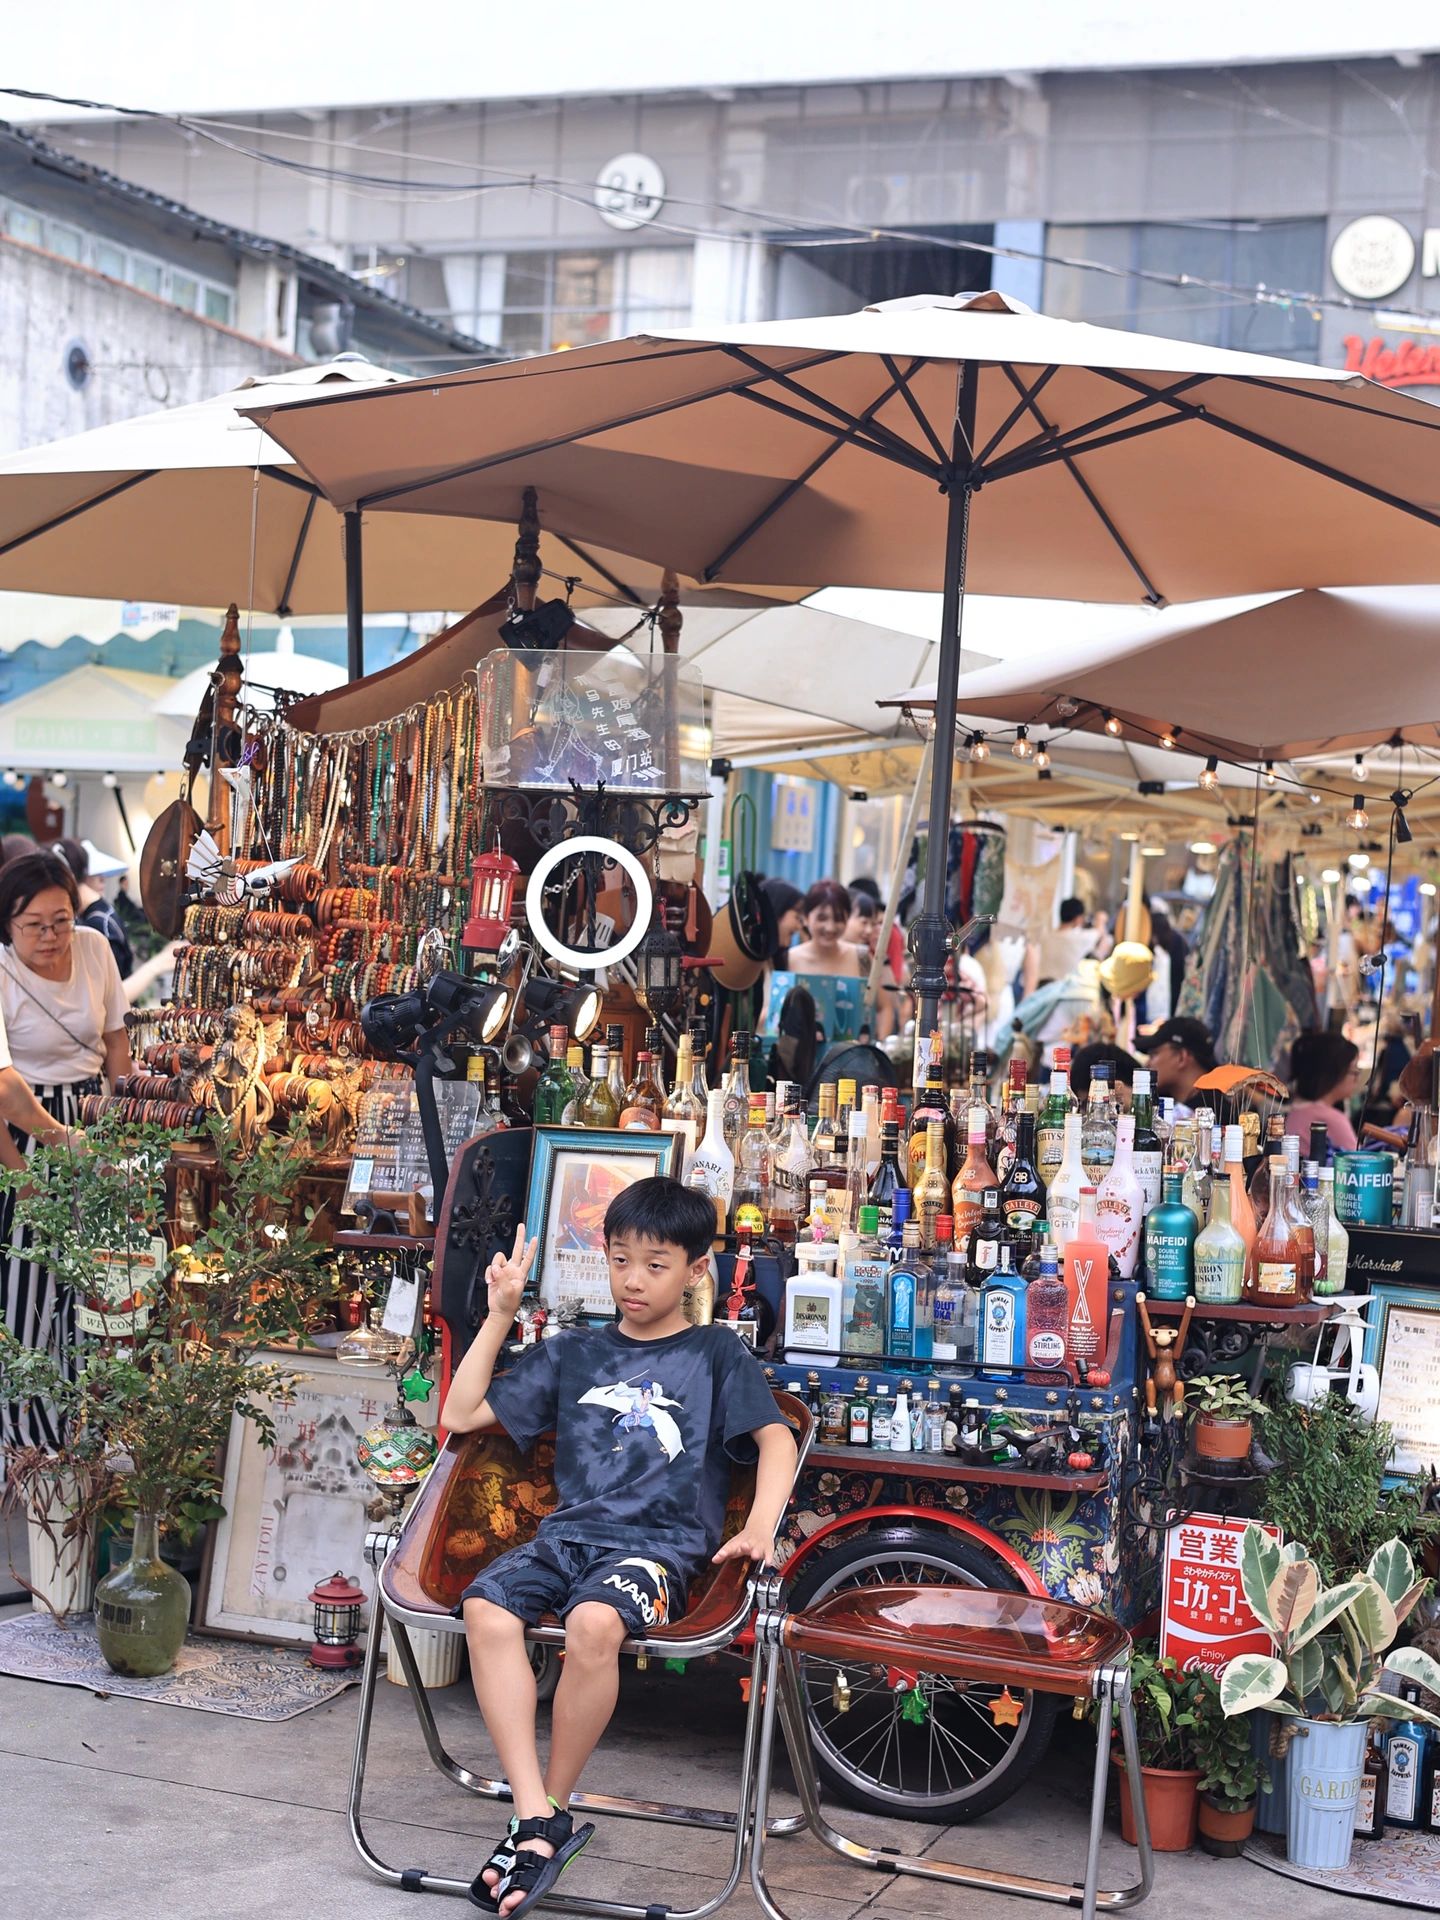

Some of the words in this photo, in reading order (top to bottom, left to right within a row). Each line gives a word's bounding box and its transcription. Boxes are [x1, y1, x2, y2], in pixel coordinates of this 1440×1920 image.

[1335, 1170, 1393, 1188] MAIFEID
[1336, 1191, 1363, 1202] DOUBLE
[1004, 1200, 1040, 1213] BAILEYS
[1097, 1200, 1130, 1214] BAILEYS
[1050, 1219, 1076, 1229] IGHT
[1146, 1235, 1188, 1247] MAIFEIDI
[1347, 1254, 1404, 1273] Marshall
[990, 1296, 1010, 1305] BOMBAY
[795, 1312, 827, 1322] DISARONNO
[86, 1316, 144, 1331] WECOME
[988, 1322, 1010, 1333] SAPPHIRE
[1033, 1341, 1061, 1350] STIRLING
[1178, 1528, 1239, 1565] 営業
[1173, 1577, 1249, 1616] コカ・コー
[1200, 1647, 1226, 1661] Enjoy
[1393, 1743, 1413, 1752] BOMBAY
[1390, 1768, 1412, 1779] SAPPHIRE
[1301, 1776, 1361, 1801] GARDE
